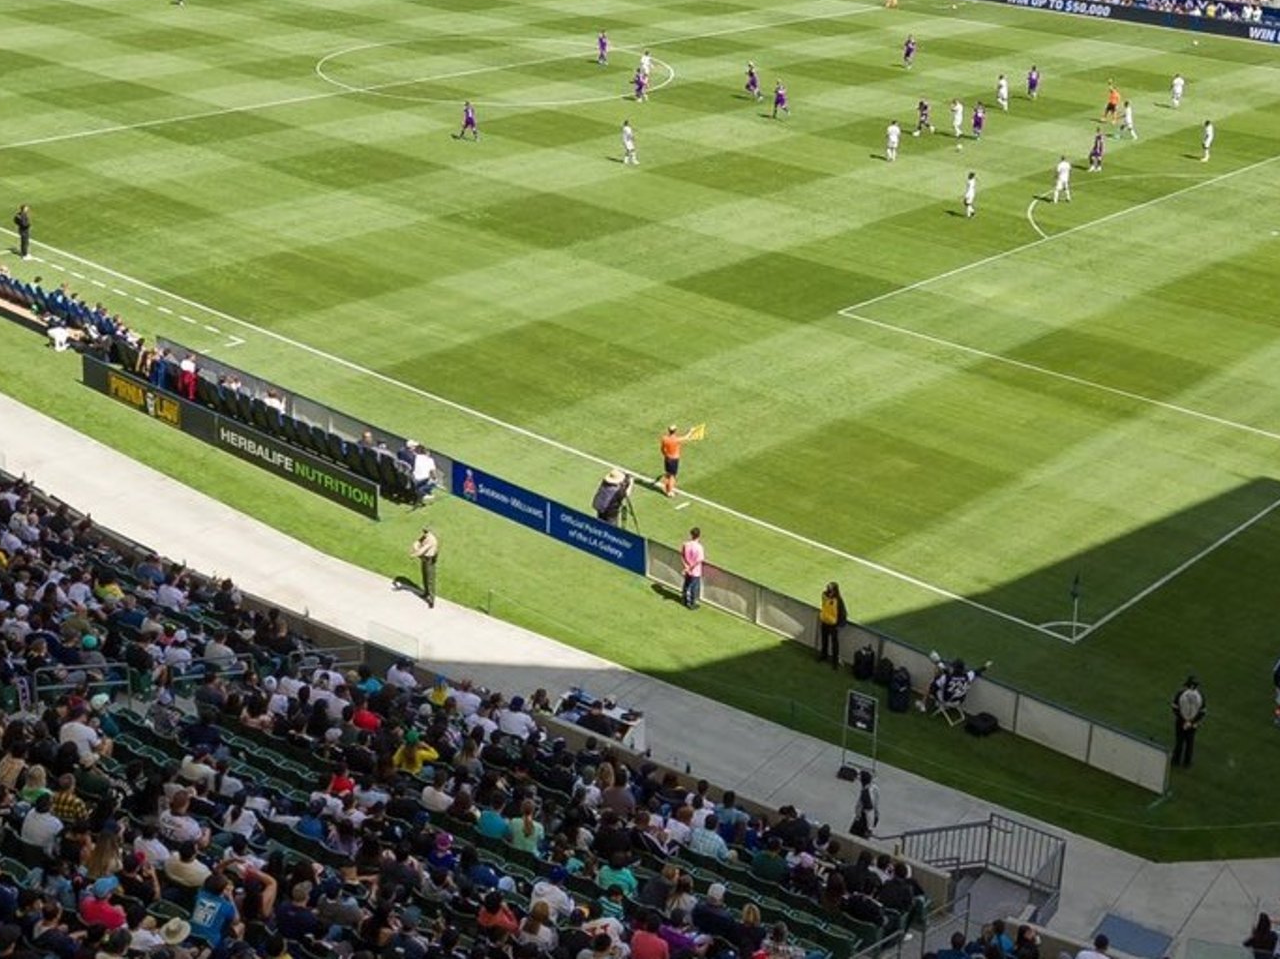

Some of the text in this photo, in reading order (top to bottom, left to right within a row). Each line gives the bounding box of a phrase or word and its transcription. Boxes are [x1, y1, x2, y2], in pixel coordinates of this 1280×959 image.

[1065, 0, 1111, 18] $50,000
[1248, 26, 1276, 41] WIN
[220, 427, 375, 508] HERBALIFE NUTRITION
[560, 513, 584, 530] Official
[604, 530, 633, 550] Provider
[568, 529, 577, 538] of
[577, 532, 588, 542] the
[589, 537, 598, 547] LA
